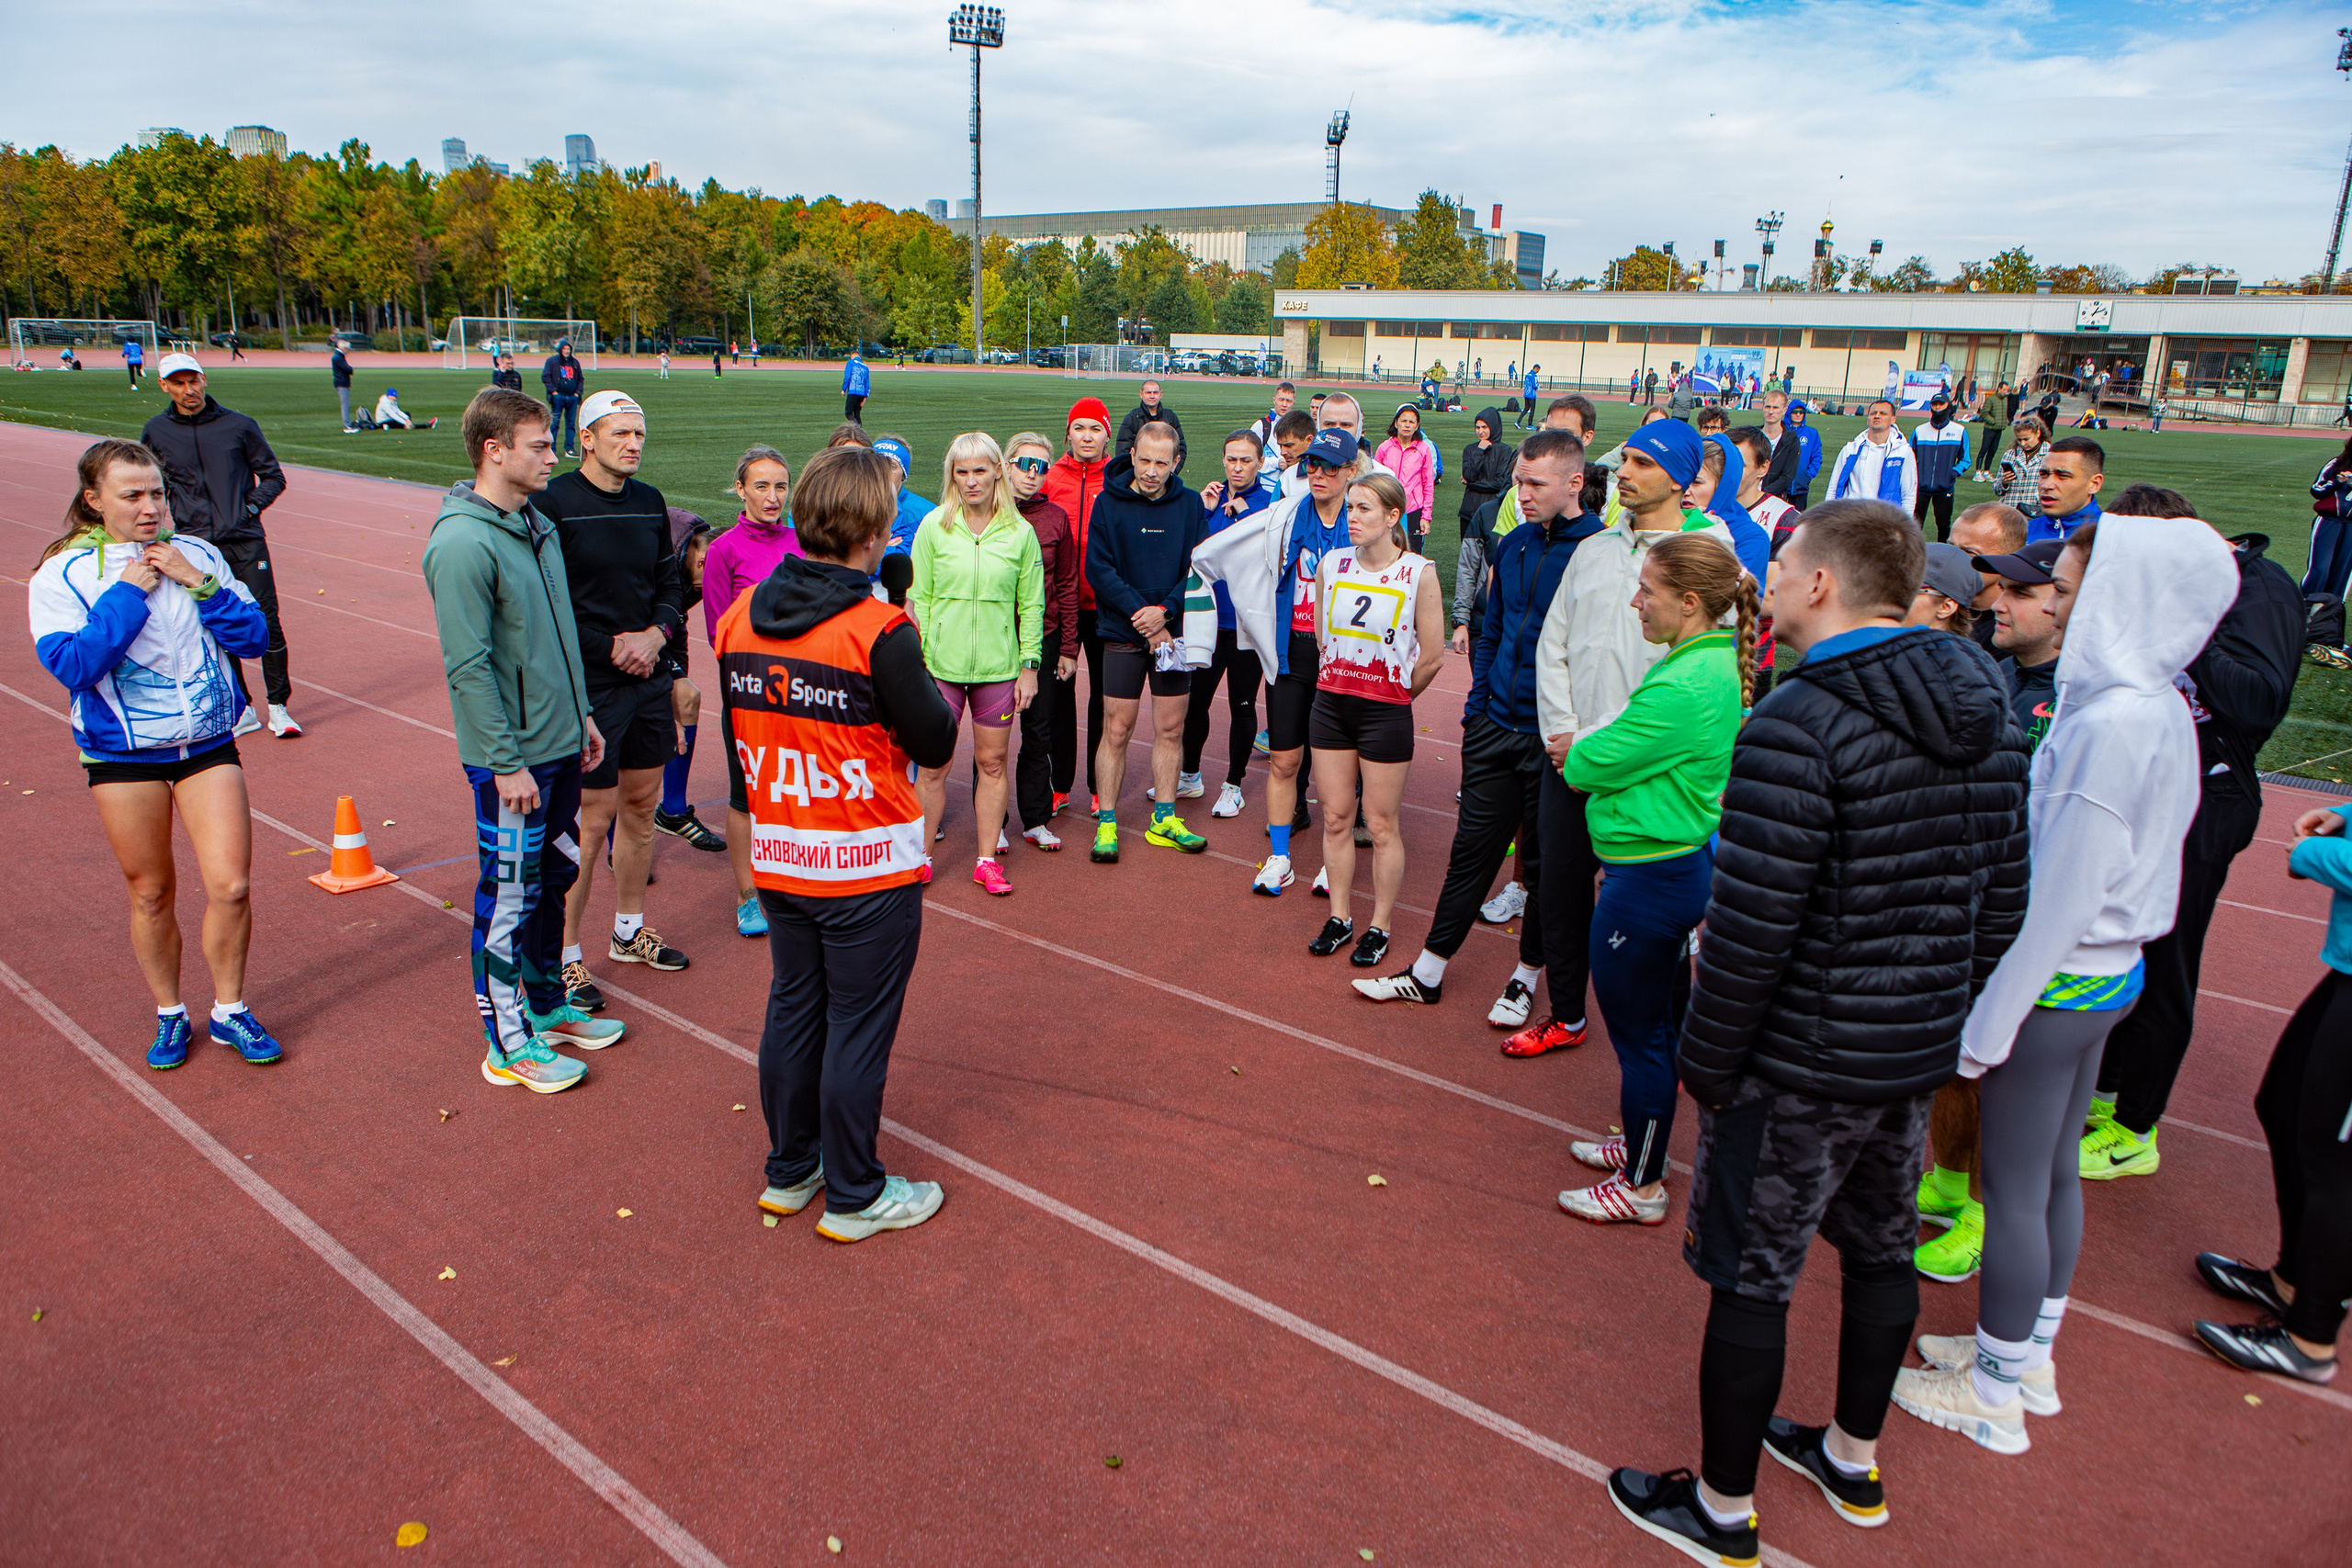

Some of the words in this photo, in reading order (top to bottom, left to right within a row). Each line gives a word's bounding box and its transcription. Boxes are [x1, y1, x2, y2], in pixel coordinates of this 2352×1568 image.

[1282, 301, 1308, 310] КАФЕ
[1294, 611, 1314, 621] МОС
[1351, 595, 1372, 628] 2
[1385, 628, 1396, 645] 3
[731, 671, 763, 694] Arta
[790, 678, 848, 710] Sport
[753, 838, 831, 869] СКОВСКИЙ
[836, 840, 892, 869] СПОРТ
